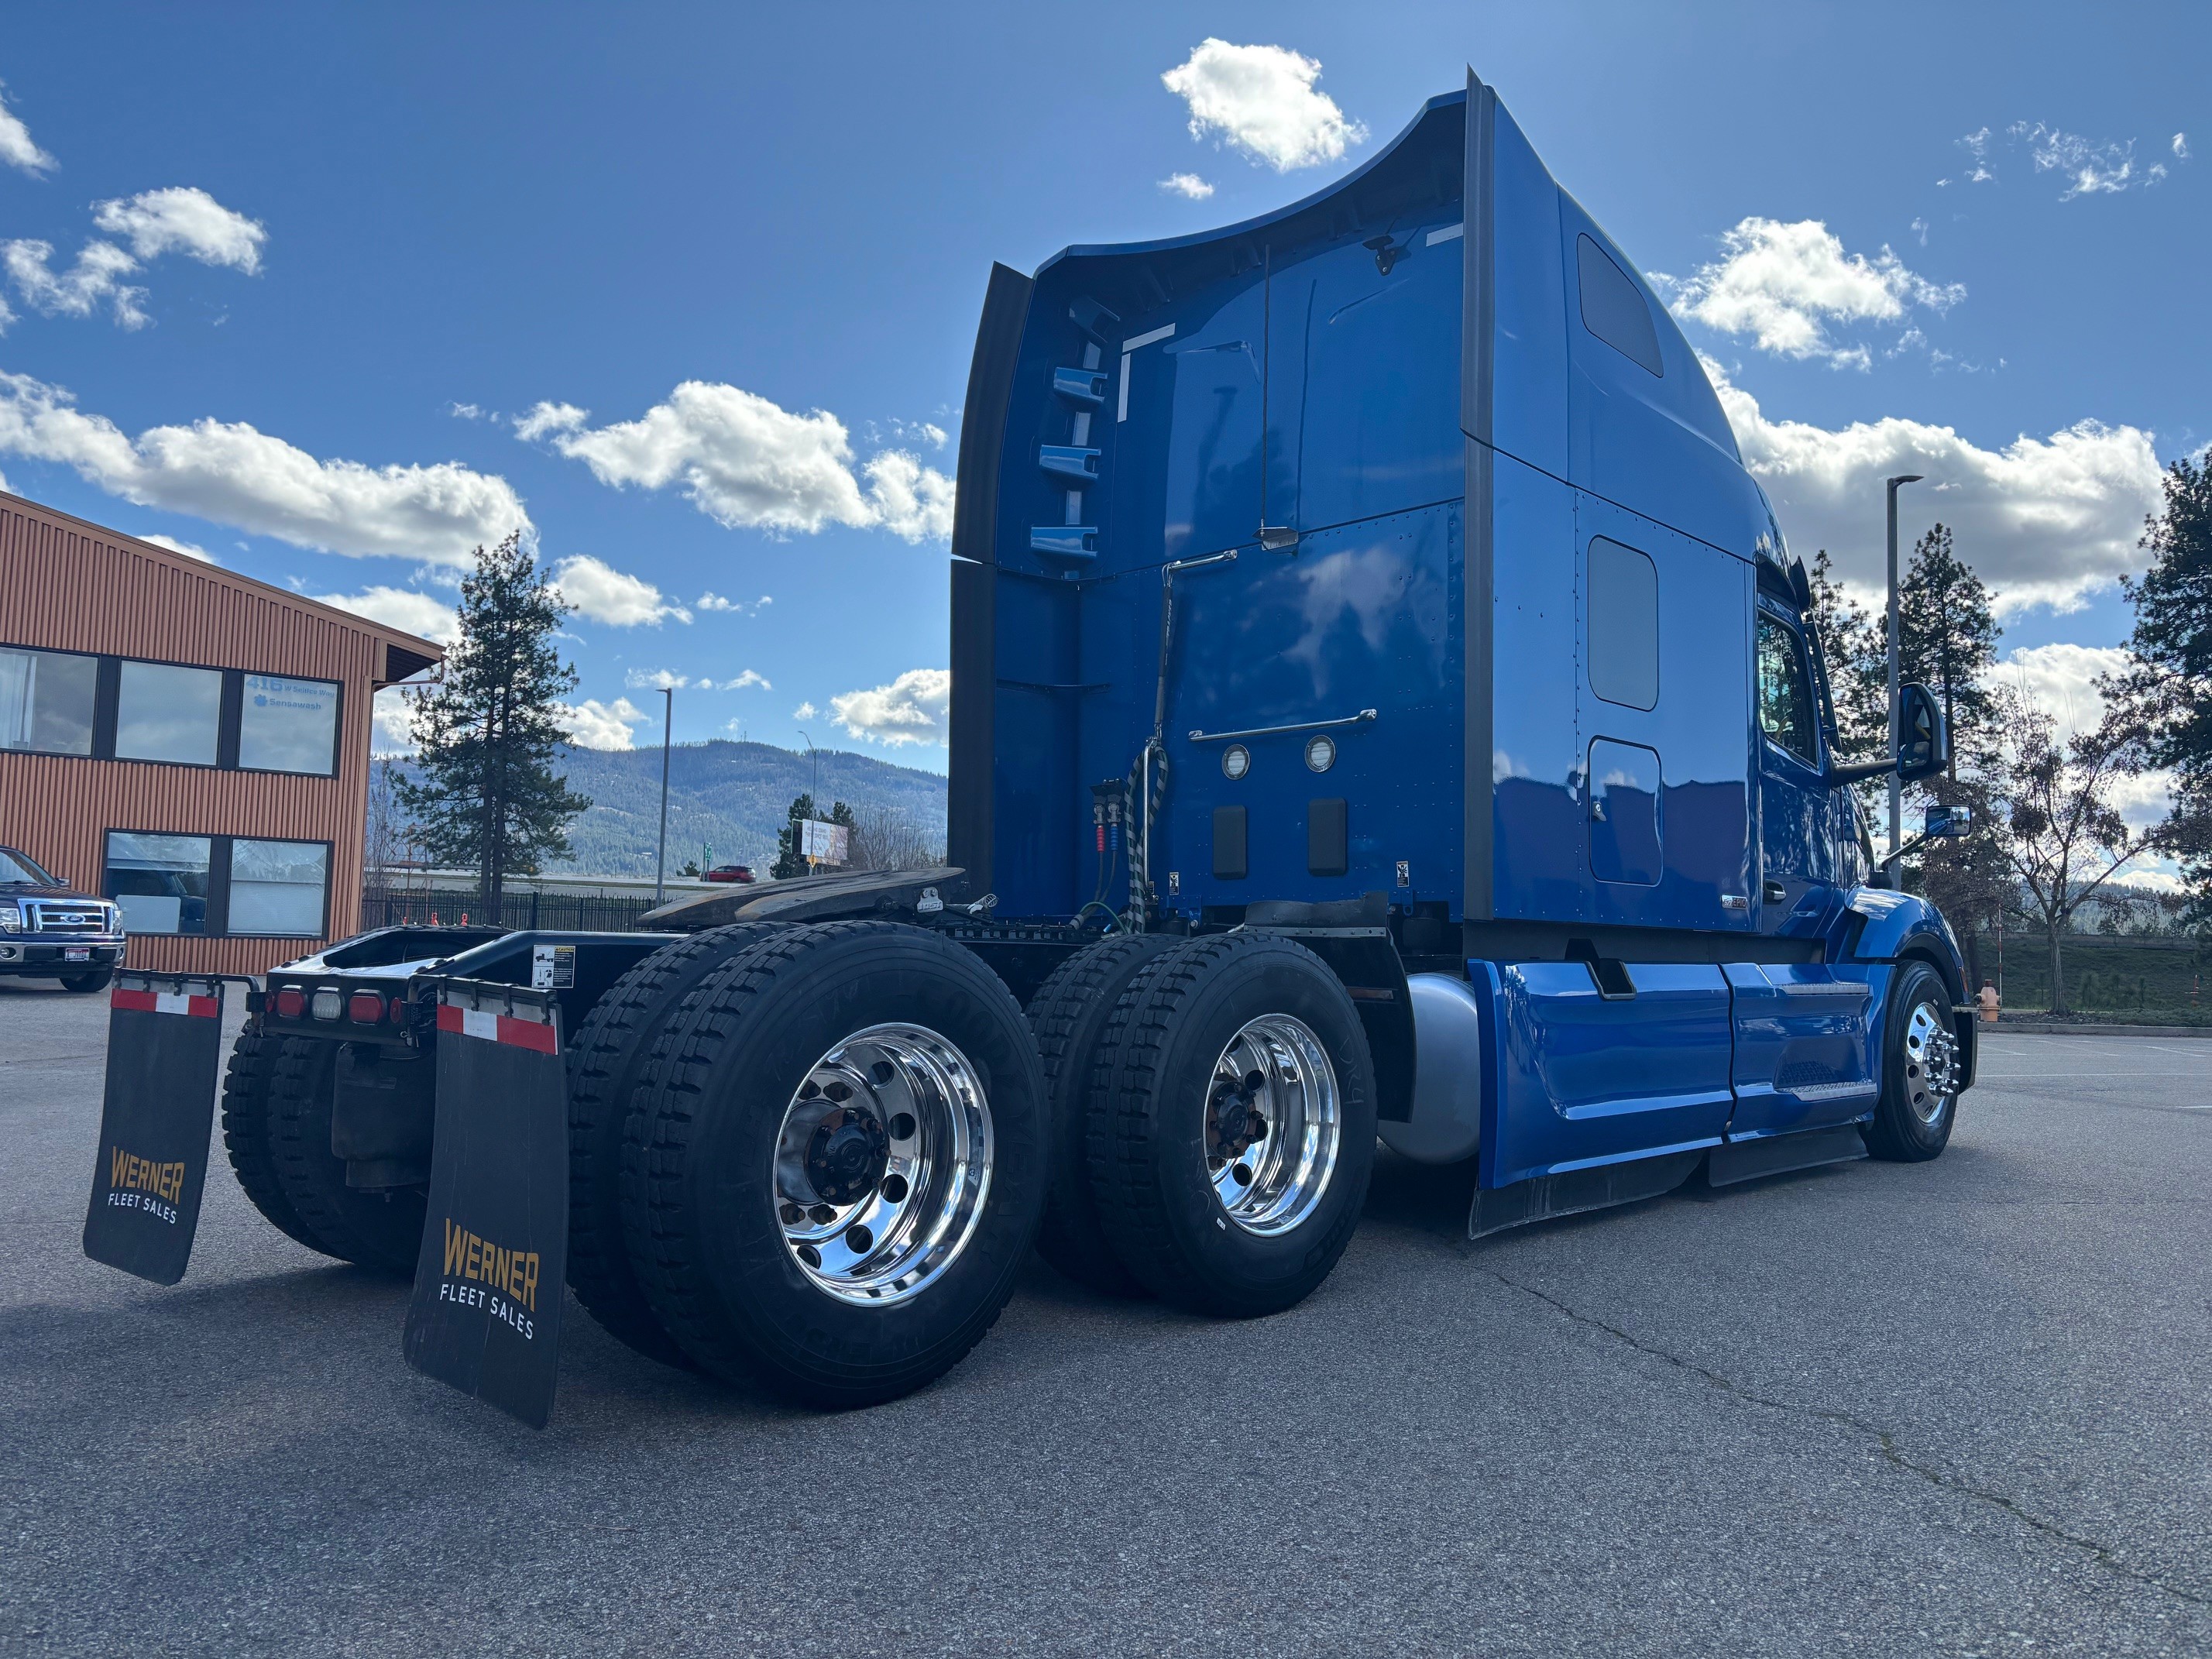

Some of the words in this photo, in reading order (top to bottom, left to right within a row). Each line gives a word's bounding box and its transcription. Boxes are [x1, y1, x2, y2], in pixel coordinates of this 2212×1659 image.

[246, 676, 283, 691] 416
[318, 689, 335, 698] Way
[111, 1146, 185, 1204] WERNER
[108, 1194, 140, 1208] FLEET
[143, 1197, 177, 1224] SALES
[443, 1218, 539, 1312] WERNER
[439, 1283, 486, 1309] FLEET
[490, 1296, 534, 1340] SALES
